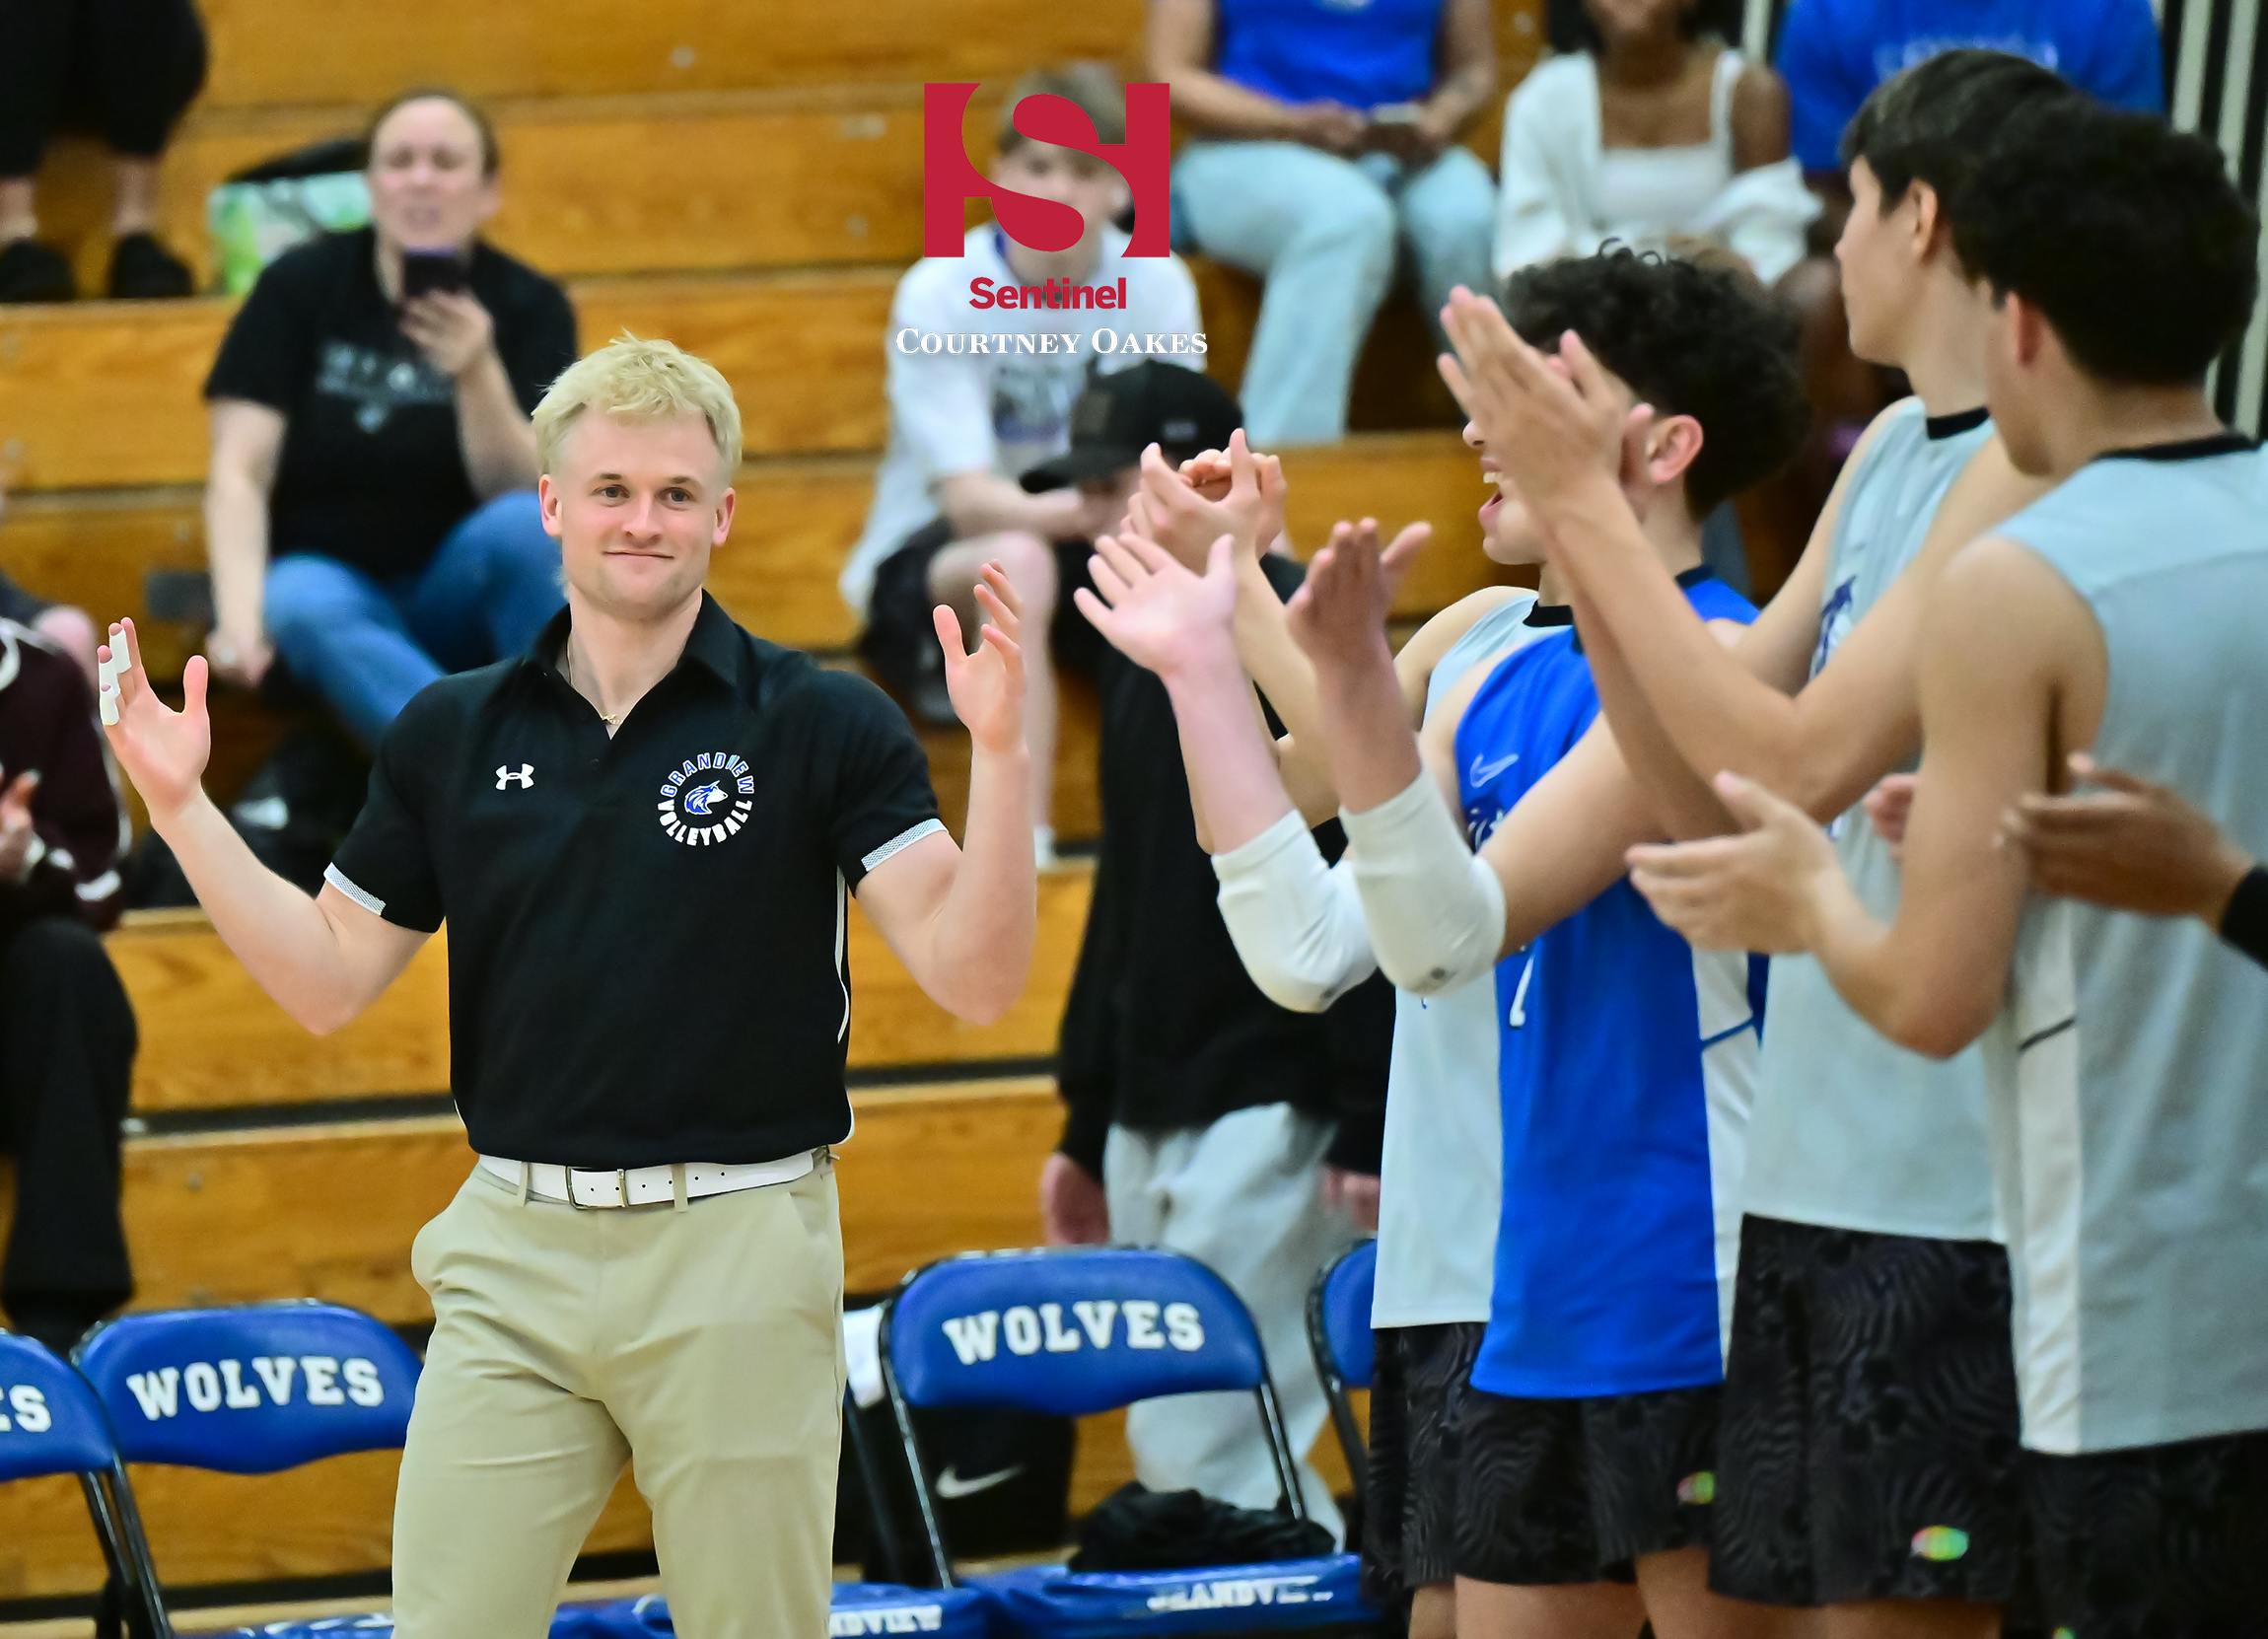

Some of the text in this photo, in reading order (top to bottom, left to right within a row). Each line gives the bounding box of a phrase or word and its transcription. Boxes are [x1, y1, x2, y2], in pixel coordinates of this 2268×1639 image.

[657, 799, 753, 846] VOLLEYBALL
[942, 1299, 1206, 1366] WOLVES
[126, 1355, 386, 1421] WOLVES
